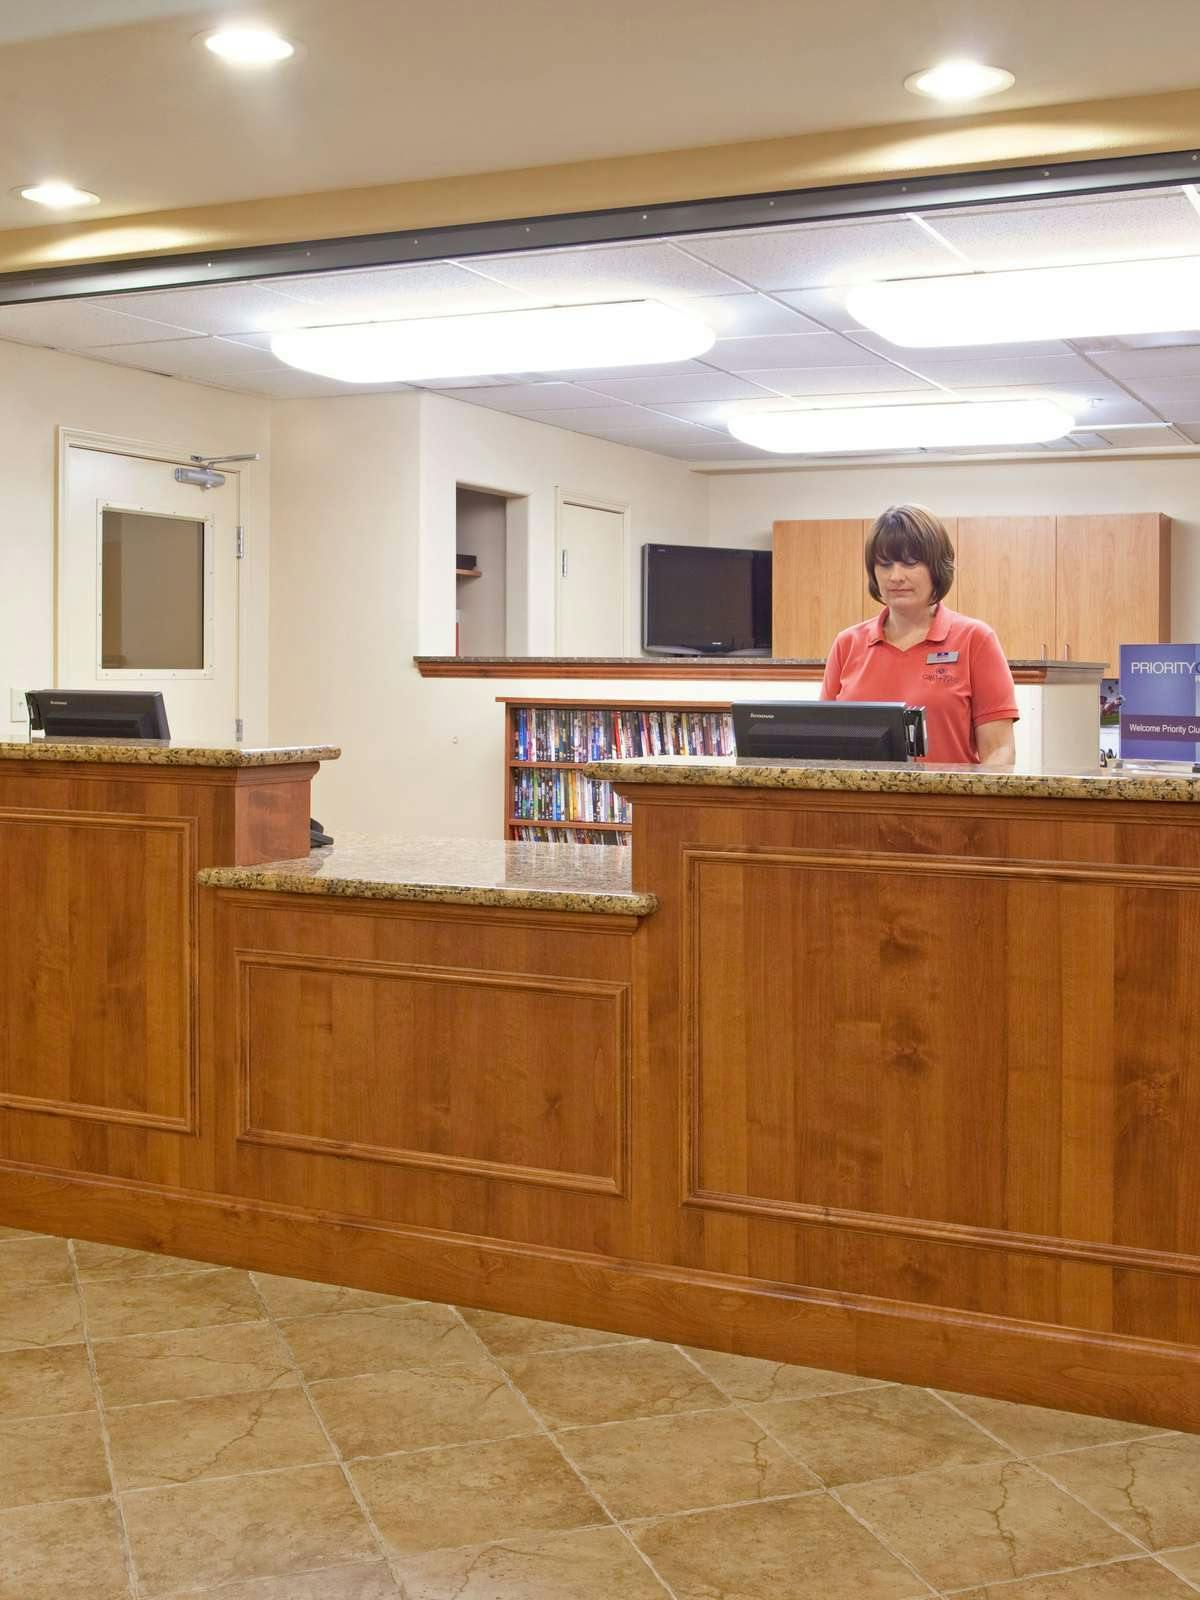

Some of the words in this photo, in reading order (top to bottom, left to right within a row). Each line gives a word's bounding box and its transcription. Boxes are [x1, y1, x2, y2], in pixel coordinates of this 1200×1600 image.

[1131, 661, 1195, 674] PRIORITY
[1129, 723, 1161, 733] Welcome
[1162, 724, 1187, 735] Priority
